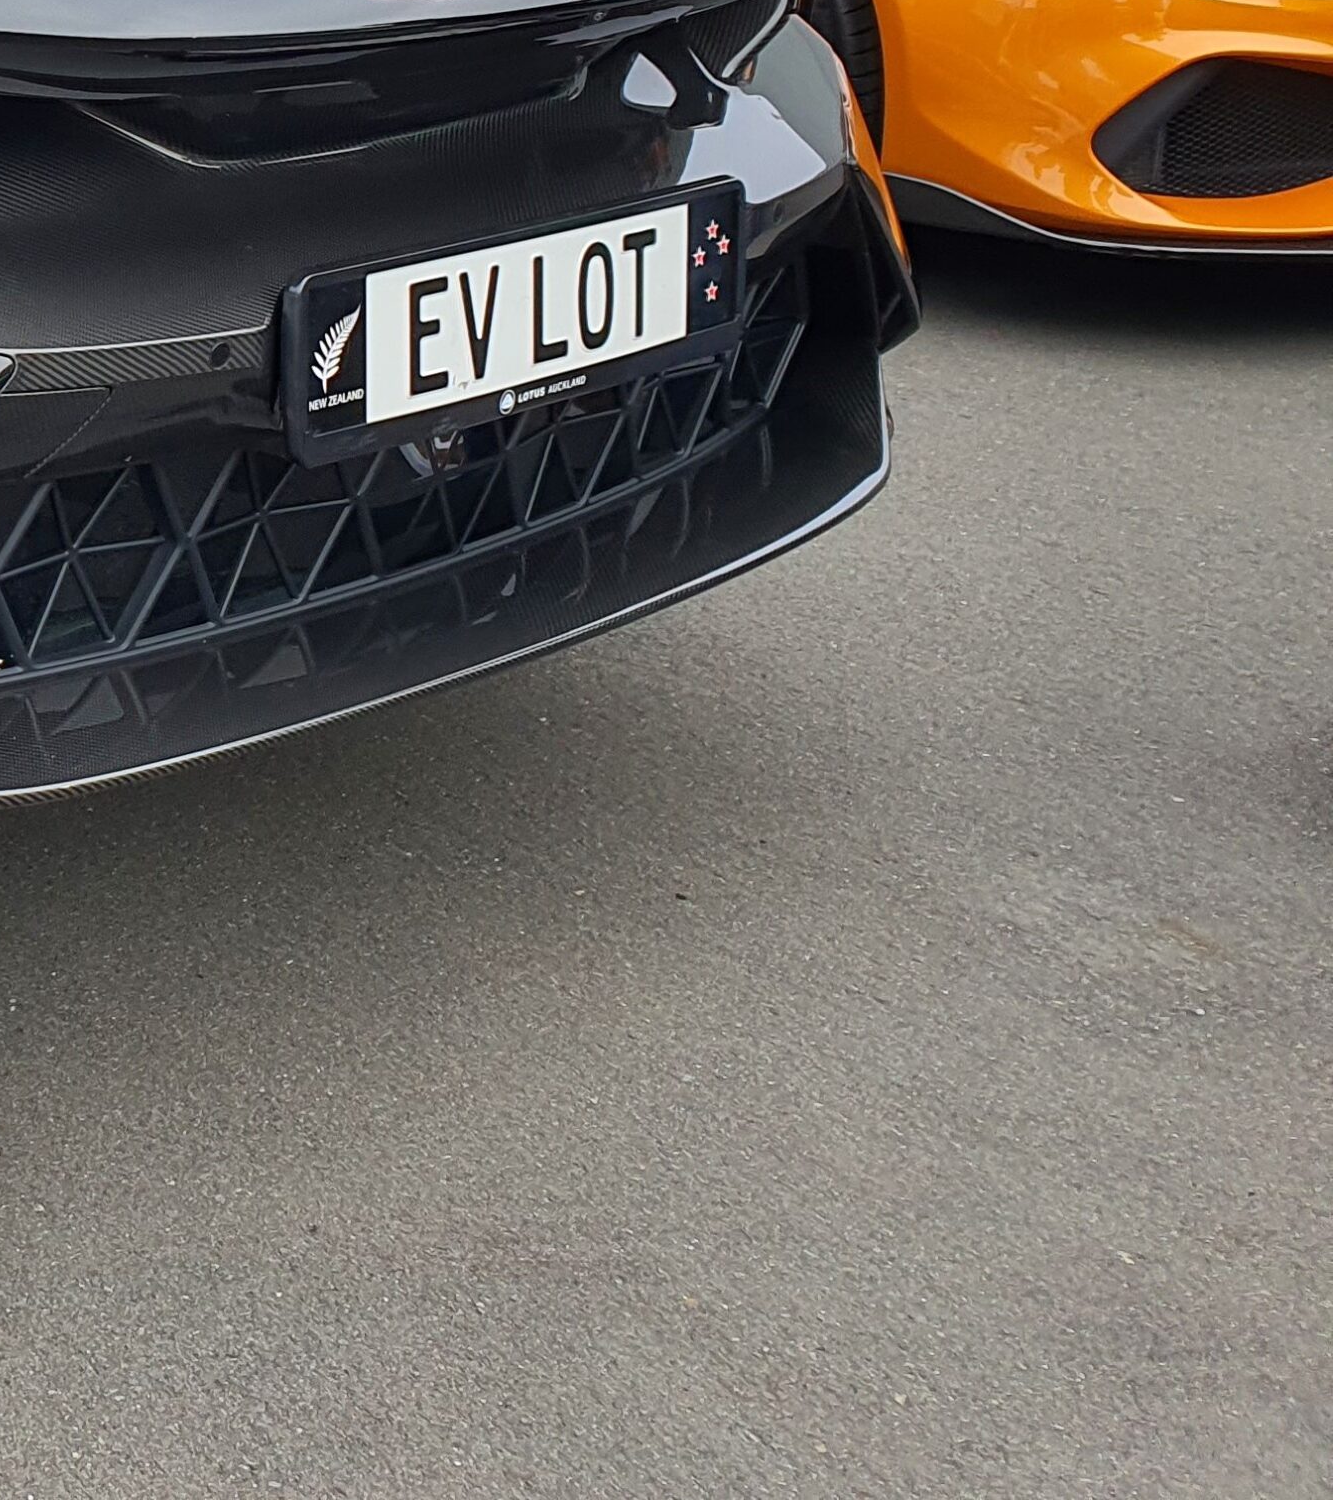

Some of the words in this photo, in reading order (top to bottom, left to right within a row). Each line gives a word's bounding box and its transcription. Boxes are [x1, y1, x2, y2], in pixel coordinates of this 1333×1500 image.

[408, 264, 500, 396] EV
[532, 227, 658, 364] LOT
[308, 397, 328, 412] NEW
[328, 388, 365, 407] ZEALAND
[517, 386, 546, 404] LOTUS
[548, 375, 587, 394] AUCKLAND
